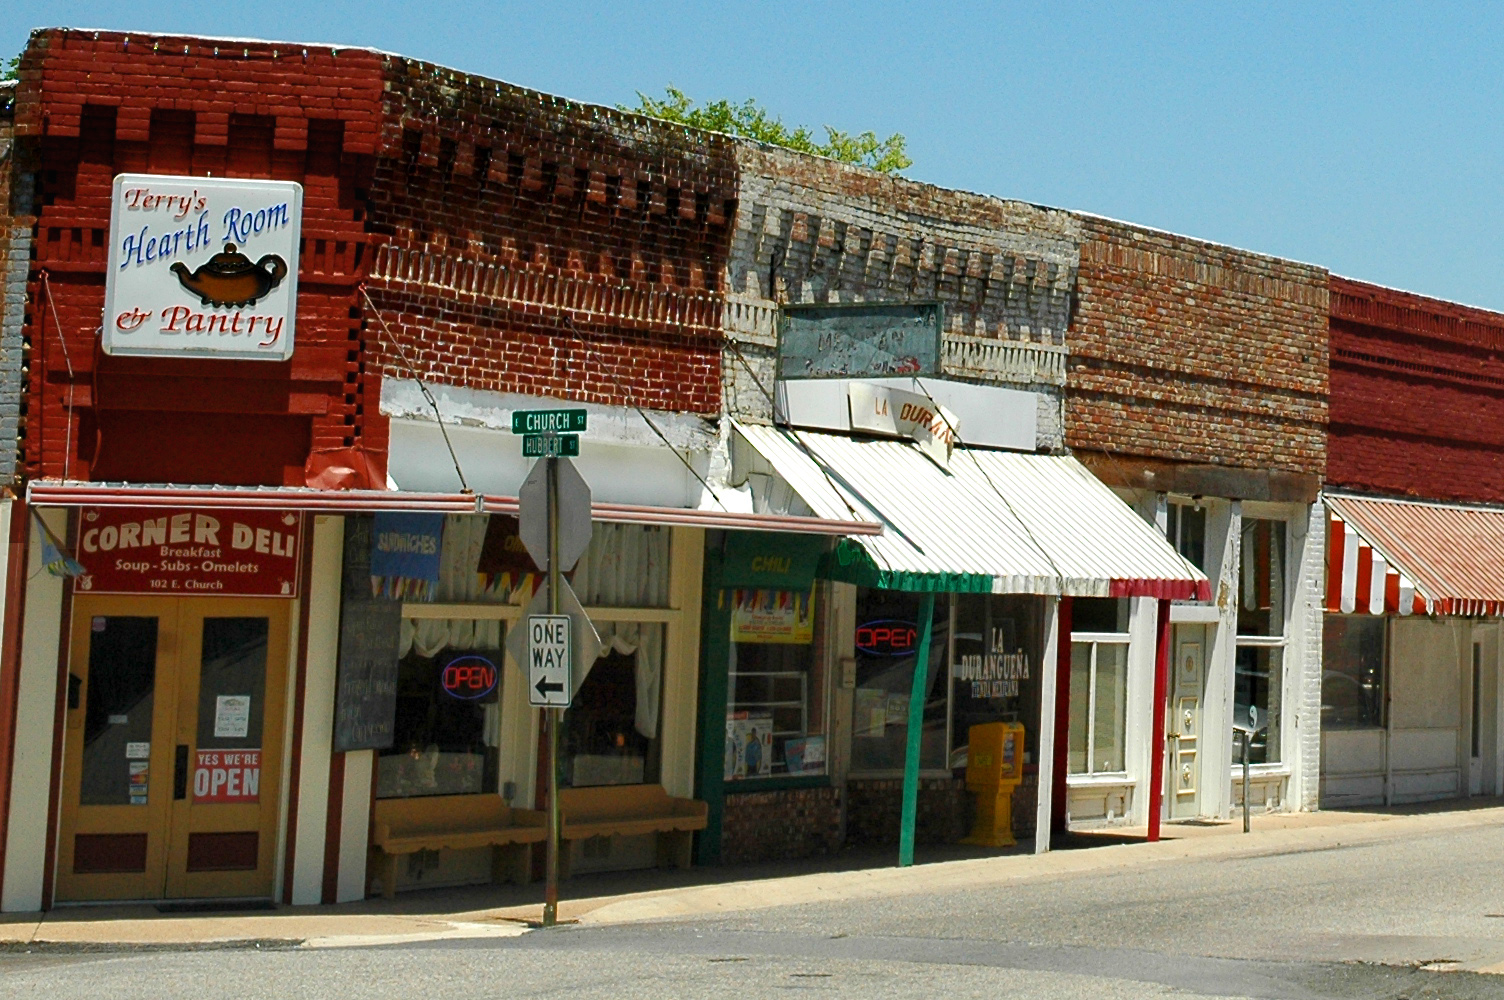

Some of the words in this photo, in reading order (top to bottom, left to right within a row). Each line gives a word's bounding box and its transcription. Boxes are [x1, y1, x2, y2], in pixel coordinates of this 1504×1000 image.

[125, 188, 206, 218] Terry's
[120, 211, 210, 269] Hearth
[223, 202, 290, 242] Room
[116, 308, 152, 333] &
[161, 306, 284, 347] Pantry
[875, 396, 888, 417] LA
[514, 417, 519, 428] E
[526, 412, 570, 430] CHURCH
[577, 415, 584, 425] ST
[526, 437, 563, 454] HUBBERT
[83, 512, 220, 553] CORNER
[231, 521, 295, 558] DELI
[160, 545, 222, 558] Breakfast
[115, 559, 150, 573] Soup
[160, 559, 191, 571] Subs
[201, 560, 259, 573] Omelets
[752, 555, 792, 574] CHILI
[150, 579, 167, 588] 102
[171, 580, 180, 588] E.
[185, 579, 223, 590] Church
[533, 624, 564, 644] ONE
[991, 627, 1004, 653] LA
[532, 648, 565, 668] WAY
[961, 648, 1030, 681] DURANGUEÑA
[445, 666, 494, 689] OPEN
[198, 753, 218, 765] YES
[224, 753, 258, 765] WE'RE
[193, 767, 260, 797] OPEN
